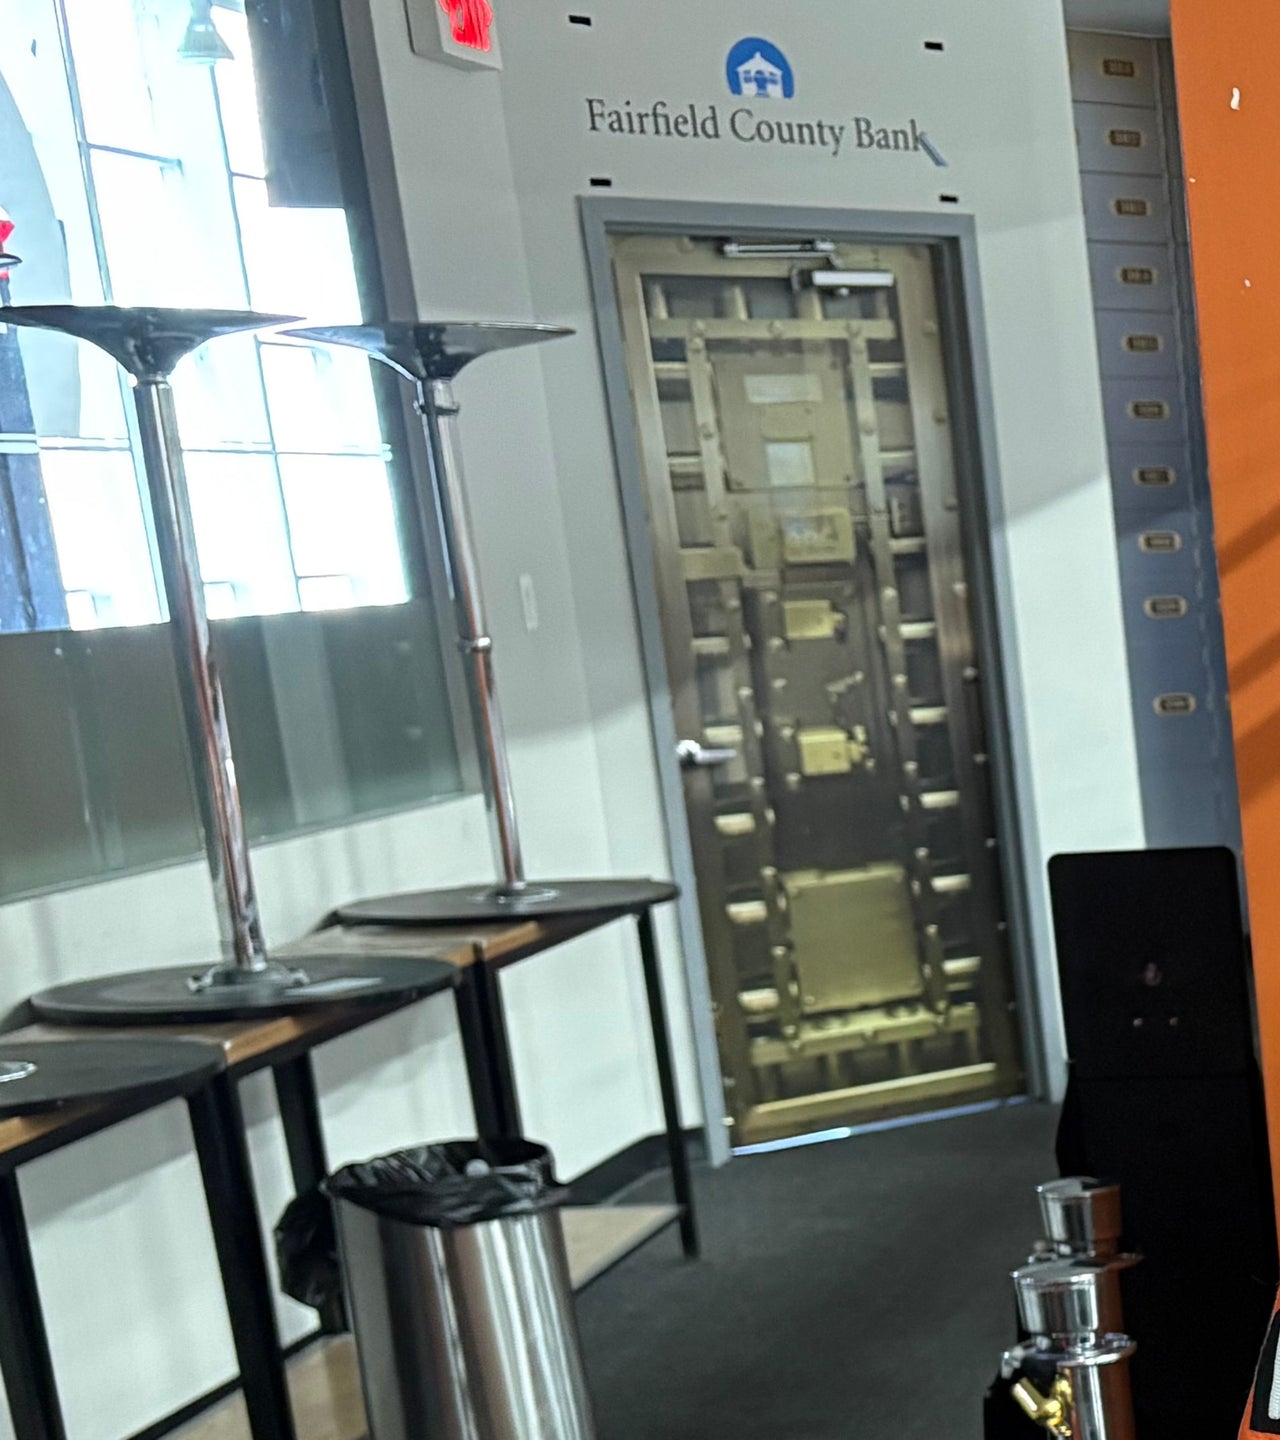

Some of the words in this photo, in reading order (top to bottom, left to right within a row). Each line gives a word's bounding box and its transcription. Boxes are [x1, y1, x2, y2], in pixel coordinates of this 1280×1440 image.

[586, 98, 721, 141] Fairfield
[730, 109, 843, 158] County
[854, 116, 926, 152] Bank
